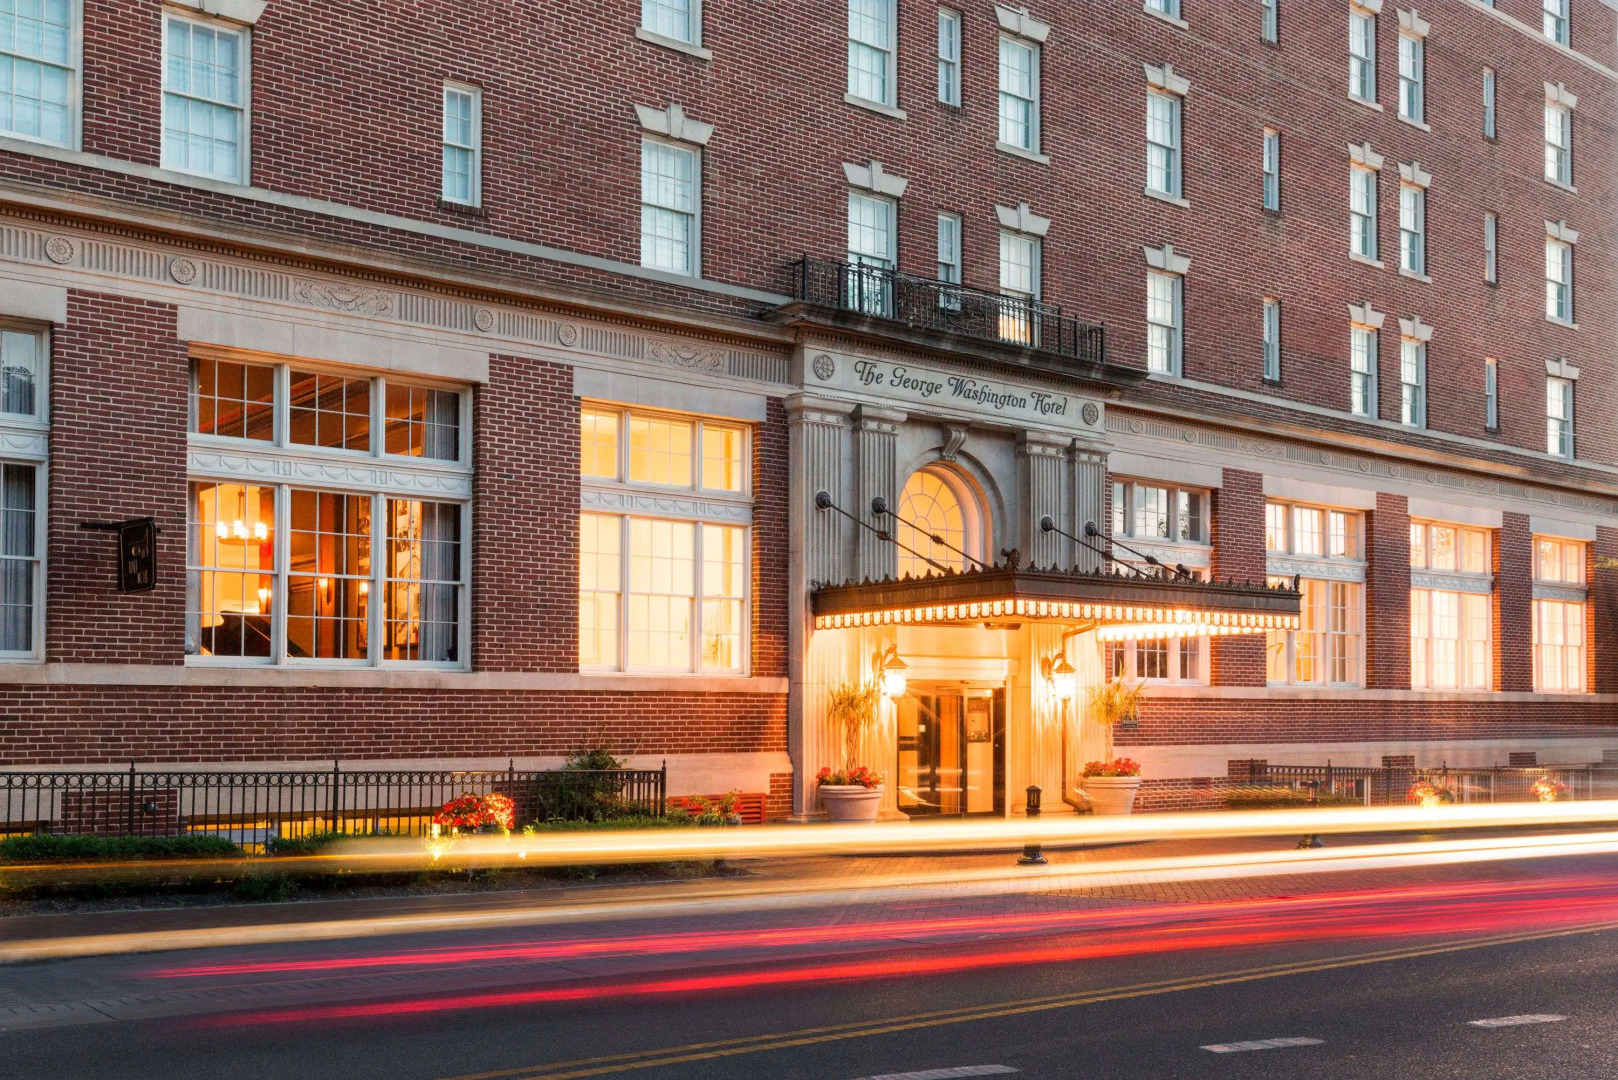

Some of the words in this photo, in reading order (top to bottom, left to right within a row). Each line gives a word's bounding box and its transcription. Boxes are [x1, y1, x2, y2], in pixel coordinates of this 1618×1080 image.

[854, 360, 884, 386] The
[890, 366, 943, 398] George
[947, 376, 1027, 410] Washington
[1030, 391, 1068, 416] Hotel
